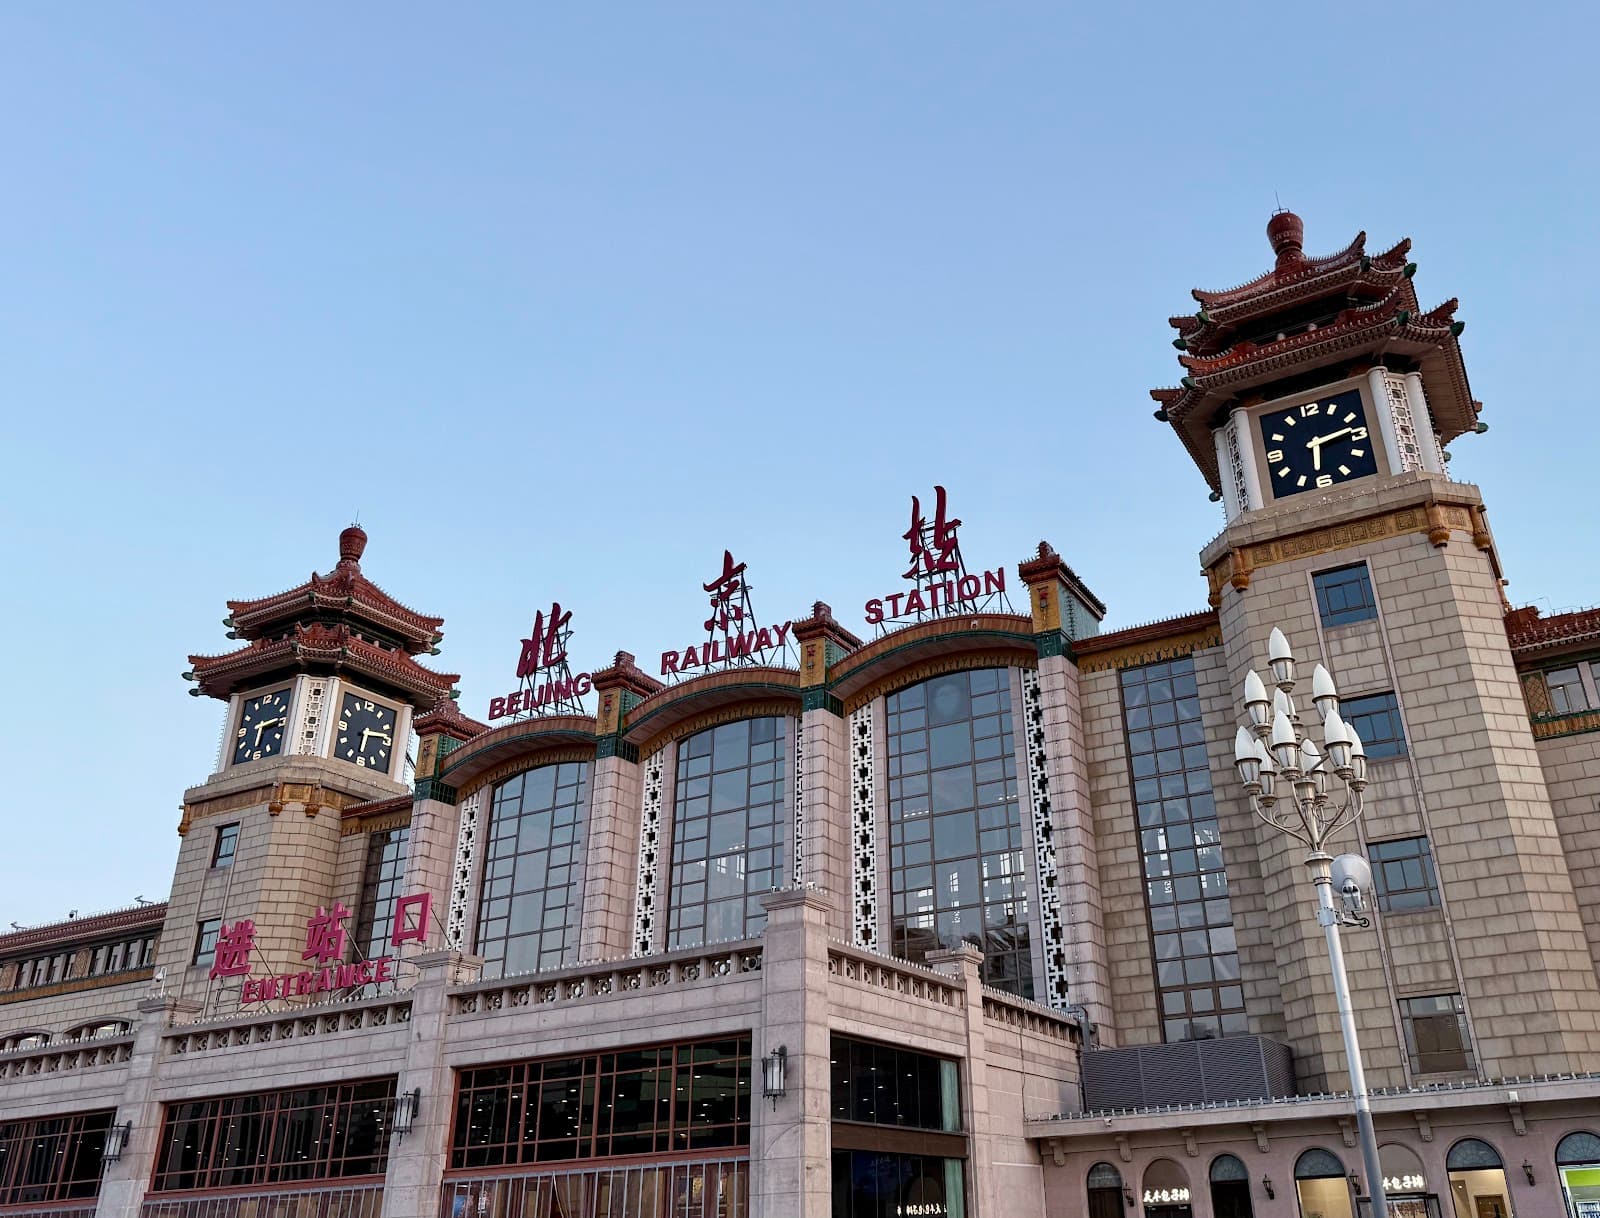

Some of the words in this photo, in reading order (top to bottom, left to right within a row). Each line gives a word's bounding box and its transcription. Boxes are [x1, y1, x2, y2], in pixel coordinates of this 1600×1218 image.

[1300, 403, 1320, 418] 12
[1267, 450, 1284, 463] 9
[1350, 426, 1368, 442] 3
[1316, 474, 1333, 488] 6
[488, 672, 592, 721] BEIJING
[660, 620, 792, 676] RAILWAY
[865, 566, 1006, 625] STATION
[262, 694, 273, 705] 12
[364, 701, 375, 712] 12
[238, 727, 247, 738] 9
[278, 716, 287, 728] 3
[338, 720, 348, 731] 9
[382, 735, 392, 747] 3
[252, 750, 261, 760] 6
[356, 756, 366, 767] 6
[209, 891, 433, 981] 进站口
[241, 955, 394, 1004] ENTRANCE
